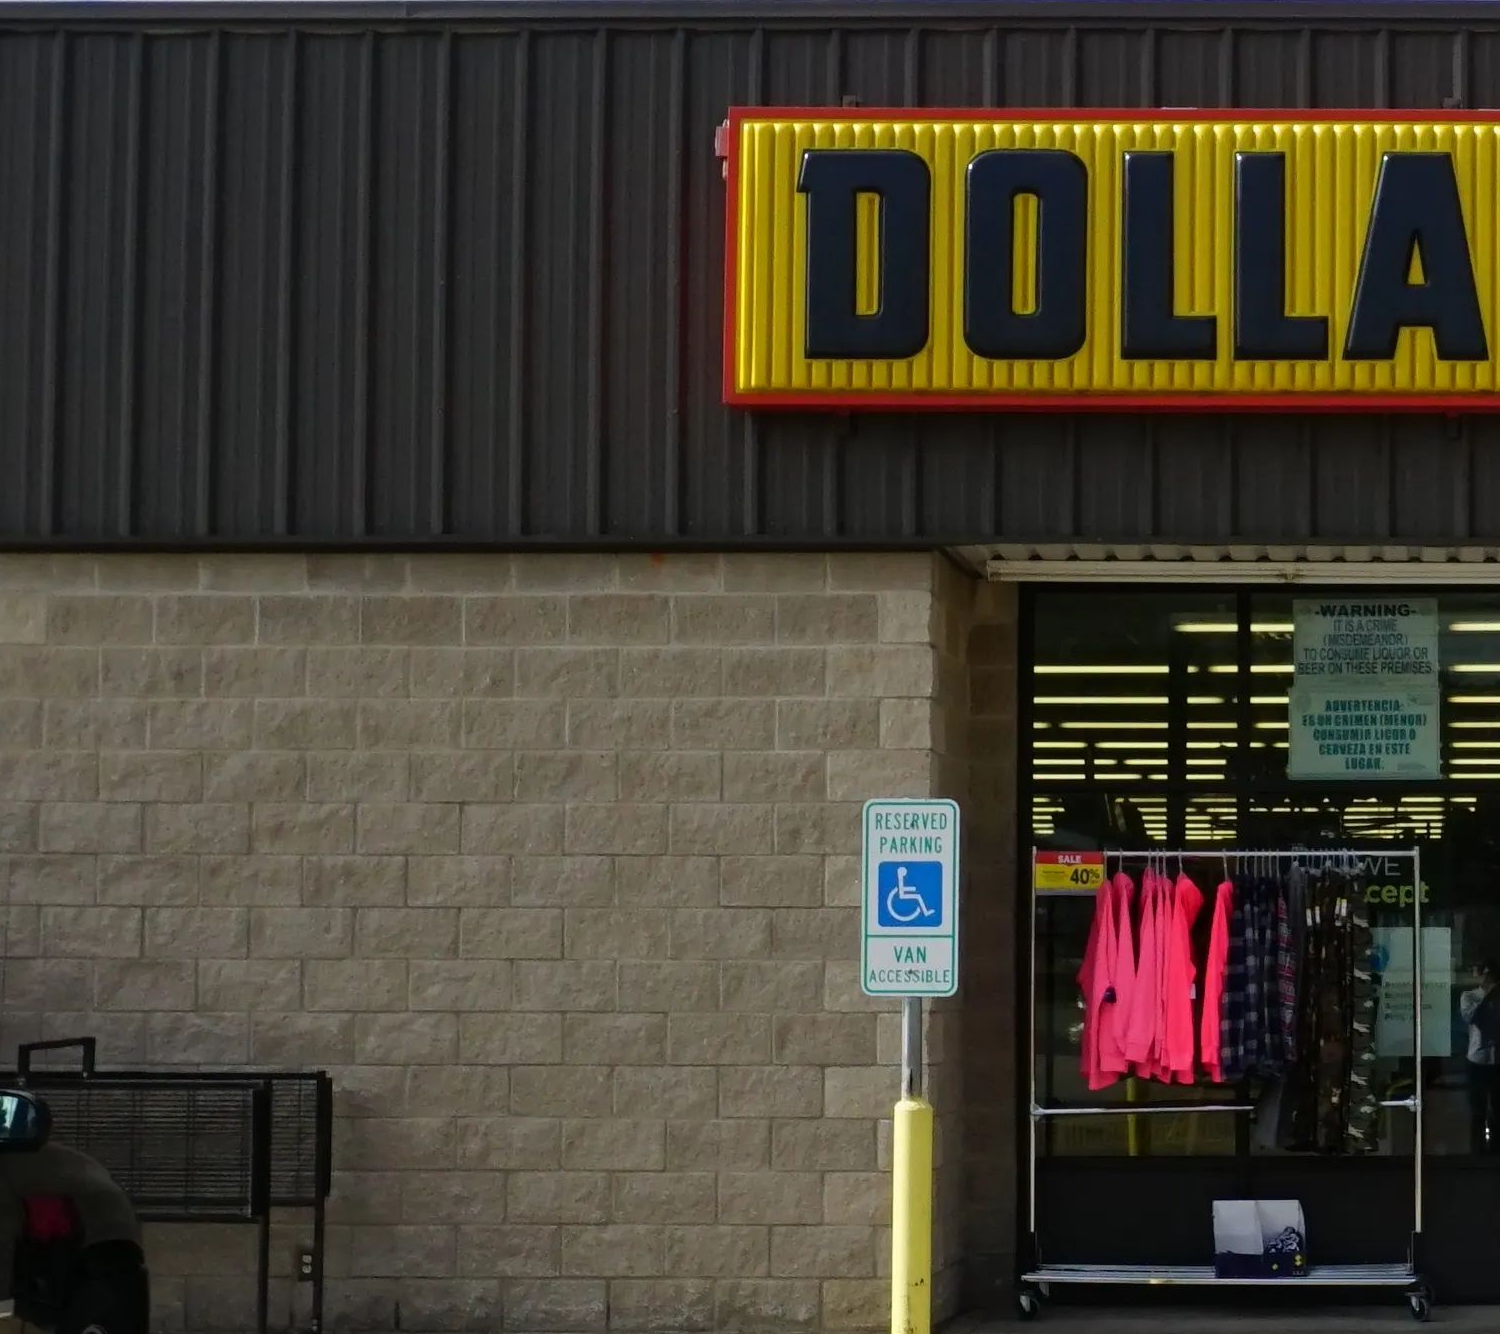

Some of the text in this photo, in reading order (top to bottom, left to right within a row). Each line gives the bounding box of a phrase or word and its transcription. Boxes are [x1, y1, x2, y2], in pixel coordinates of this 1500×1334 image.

[1333, 619, 1398, 632] IT IS A CRIME
[1323, 633, 1409, 646] (MISDEMEANOR)
[1304, 647, 1428, 661] TO CONSUME LIQUOR OR
[1298, 661, 1326, 675] BEER
[1329, 661, 1343, 675] ON
[1346, 661, 1378, 675] THESE
[1302, 714, 1428, 727] ES UN CRIMEN (MENOR)
[1313, 729, 1373, 741] CONSUMIR
[1409, 729, 1416, 741] O
[1319, 743, 1411, 755] CERVEZA EN ESTE
[875, 813, 948, 830] RESERVED
[880, 836, 943, 854] PARKING
[1058, 855, 1082, 864] SALE
[1070, 868, 1100, 884] 40%
[1364, 880, 1430, 907] cept
[894, 946, 927, 963] VAN
[869, 969, 950, 983] ACCESSIBLE
